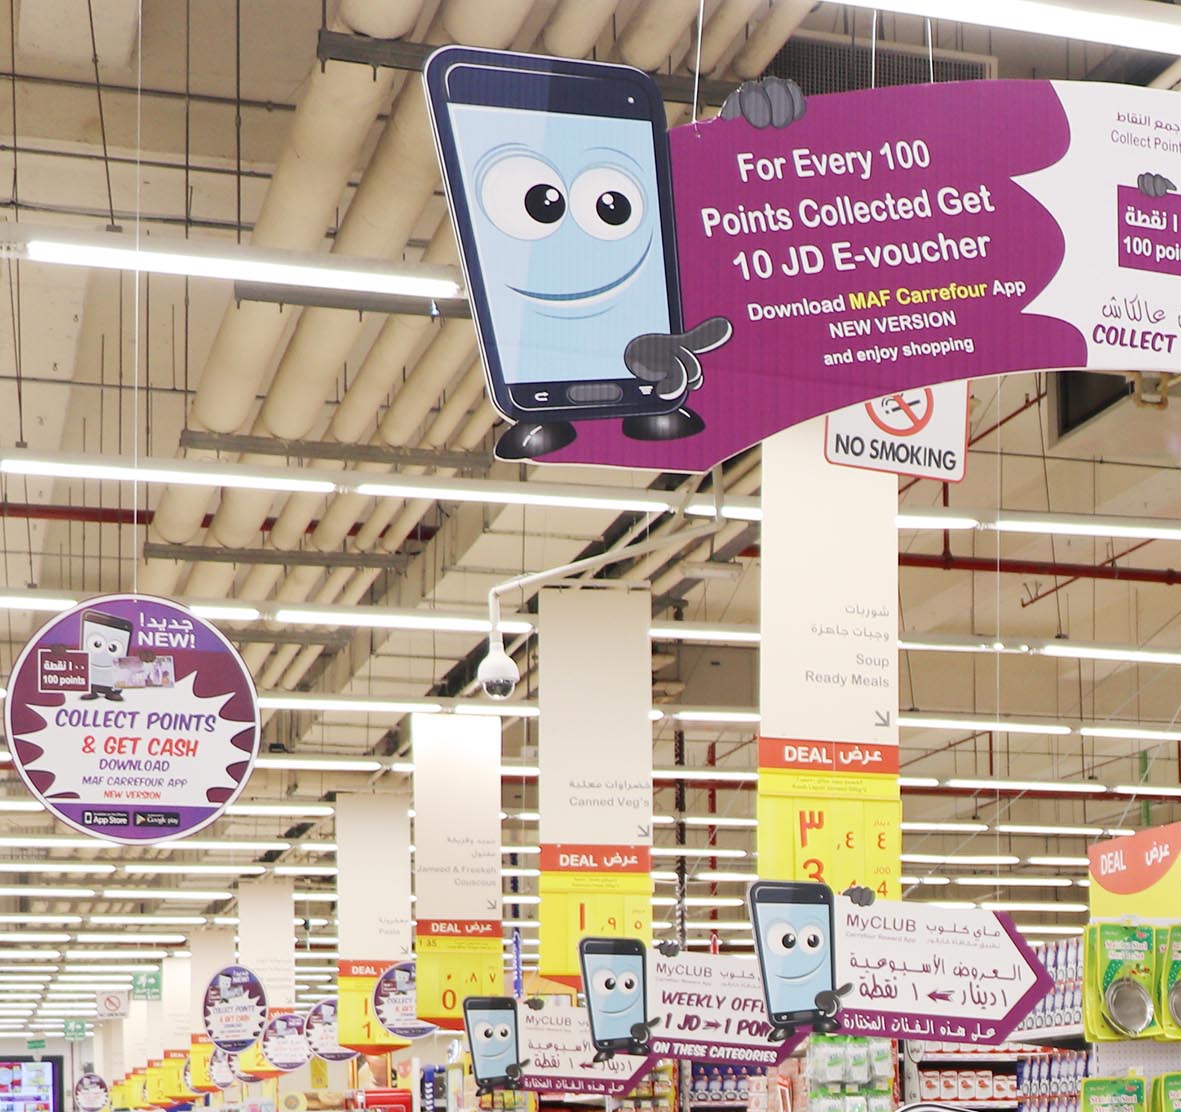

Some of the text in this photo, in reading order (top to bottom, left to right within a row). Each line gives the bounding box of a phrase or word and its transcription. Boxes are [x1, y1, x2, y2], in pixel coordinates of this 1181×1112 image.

[1116, 111, 1151, 128] النقاط
[1110, 130, 1151, 149] Collect
[736, 139, 930, 184] For Every 100
[701, 183, 995, 239] Points Collected Get
[1124, 205, 1167, 231] نقطة
[1123, 235, 1152, 257] 100
[732, 232, 992, 283] 10 JD E-voucher
[747, 277, 1027, 322] Download MAF Carrefour App
[828, 310, 957, 339] NEW VERSION
[1092, 323, 1178, 354] COLLECT
[823, 336, 975, 366] and enjoy shopping
[835, 433, 957, 471] NO SMOKING
[138, 631, 196, 649] NEW!
[855, 653, 890, 668] Soup
[42, 675, 86, 687] 100 points
[805, 671, 890, 688] Ready Meals
[55, 708, 217, 733] COLLECT POINTS
[81, 735, 199, 757] & GET CASH
[784, 745, 882, 765] DEAL عرض
[99, 759, 170, 772] DOWNLOAD
[82, 776, 188, 788] MAF CARREFOUR APP
[104, 790, 161, 800] NEW VERSION
[569, 796, 614, 807] Canned
[93, 814, 128, 825] App Store
[559, 852, 638, 867] DEAL عرض
[1100, 840, 1171, 877] DEAL عرض
[431, 923, 493, 933] DEAL عرض
[846, 914, 917, 933] MyCLUB
[351, 966, 377, 975] DEAL
[656, 963, 712, 978] MyCLUB
[953, 962, 1022, 981] العروض
[859, 973, 898, 999] نقطة
[662, 990, 726, 1009] WEEKLY
[525, 1015, 572, 1025] MyCLUB
[677, 1013, 700, 1031] JD
[653, 1041, 778, 1063] ON THESE CATEGORIES
